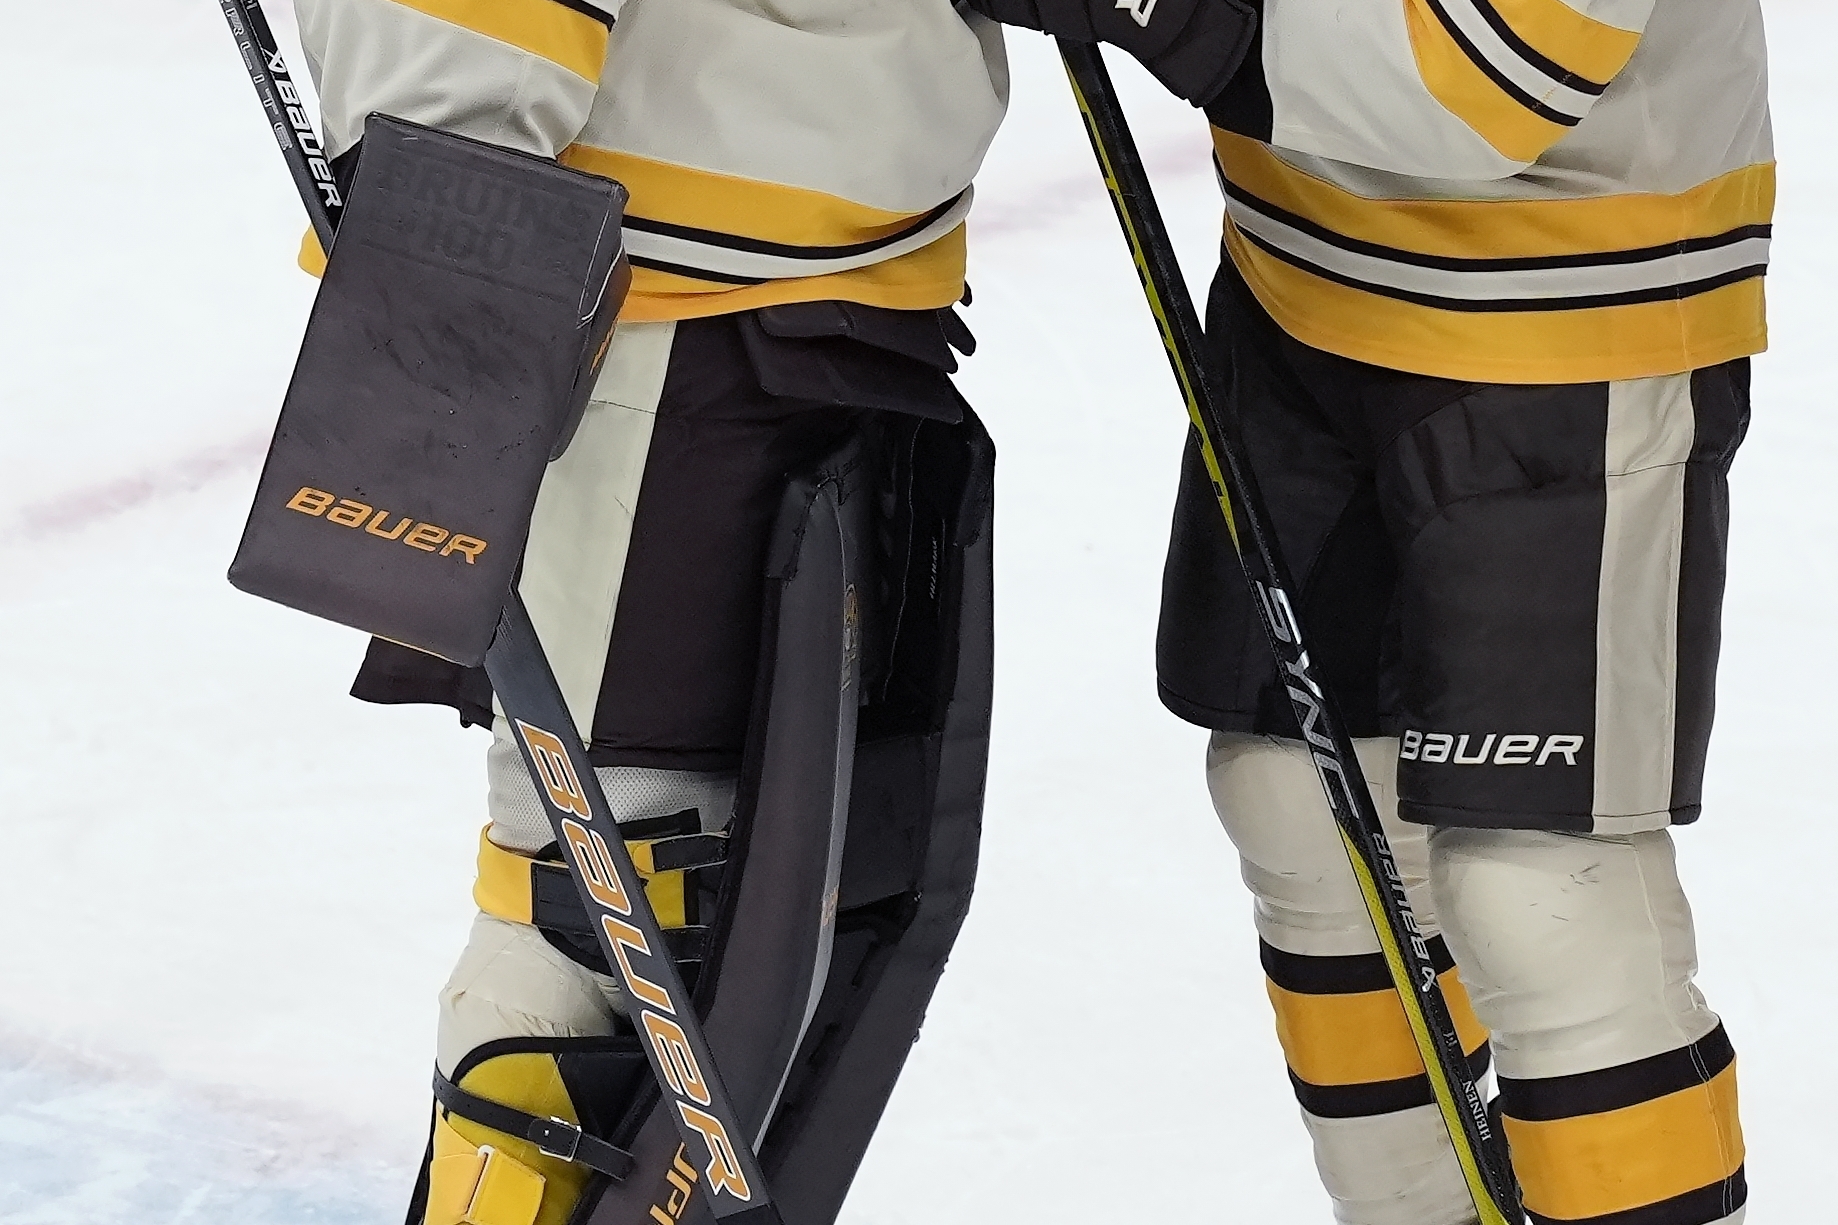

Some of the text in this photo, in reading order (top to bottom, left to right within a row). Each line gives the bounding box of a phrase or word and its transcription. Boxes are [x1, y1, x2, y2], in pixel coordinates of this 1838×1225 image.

[274, 80, 343, 207] BAUER
[285, 485, 489, 566] BAUER
[1255, 579, 1360, 820] SYNC
[1400, 729, 1584, 766] BAUER
[514, 717, 752, 1202] BAUER
[1462, 1080, 1492, 1142] HEINEN
